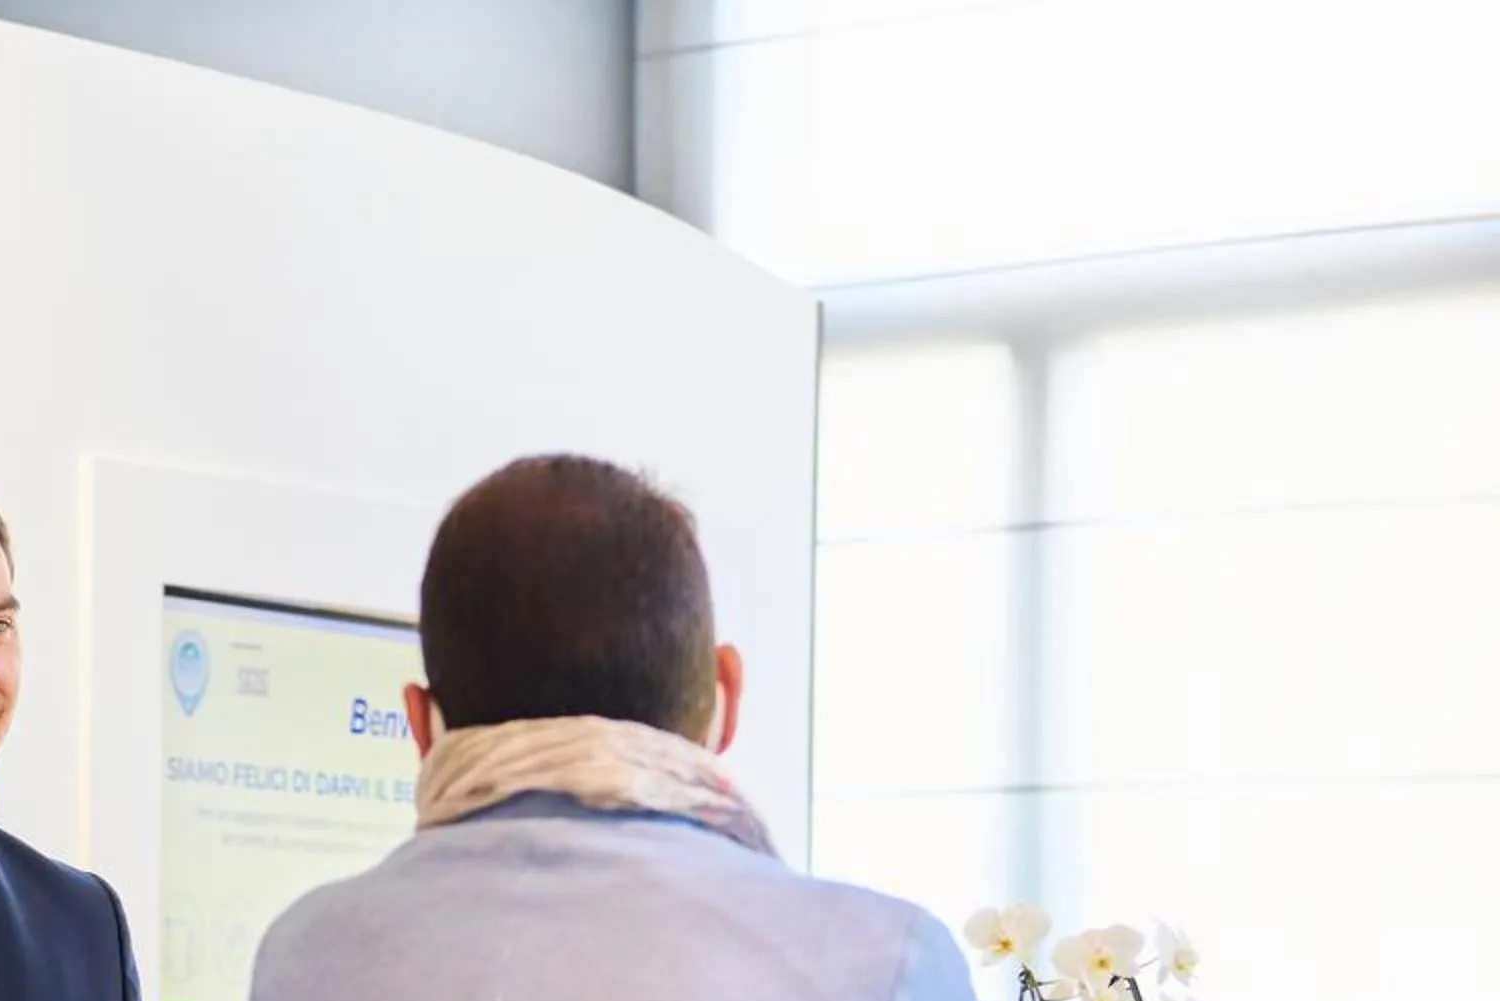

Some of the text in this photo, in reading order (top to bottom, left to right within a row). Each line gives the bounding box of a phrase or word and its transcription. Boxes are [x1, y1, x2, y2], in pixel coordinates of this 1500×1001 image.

[166, 756, 228, 785] SIAMO
[233, 762, 288, 792] FELICI
[293, 768, 310, 794] DI
[315, 769, 369, 798] DARVI
